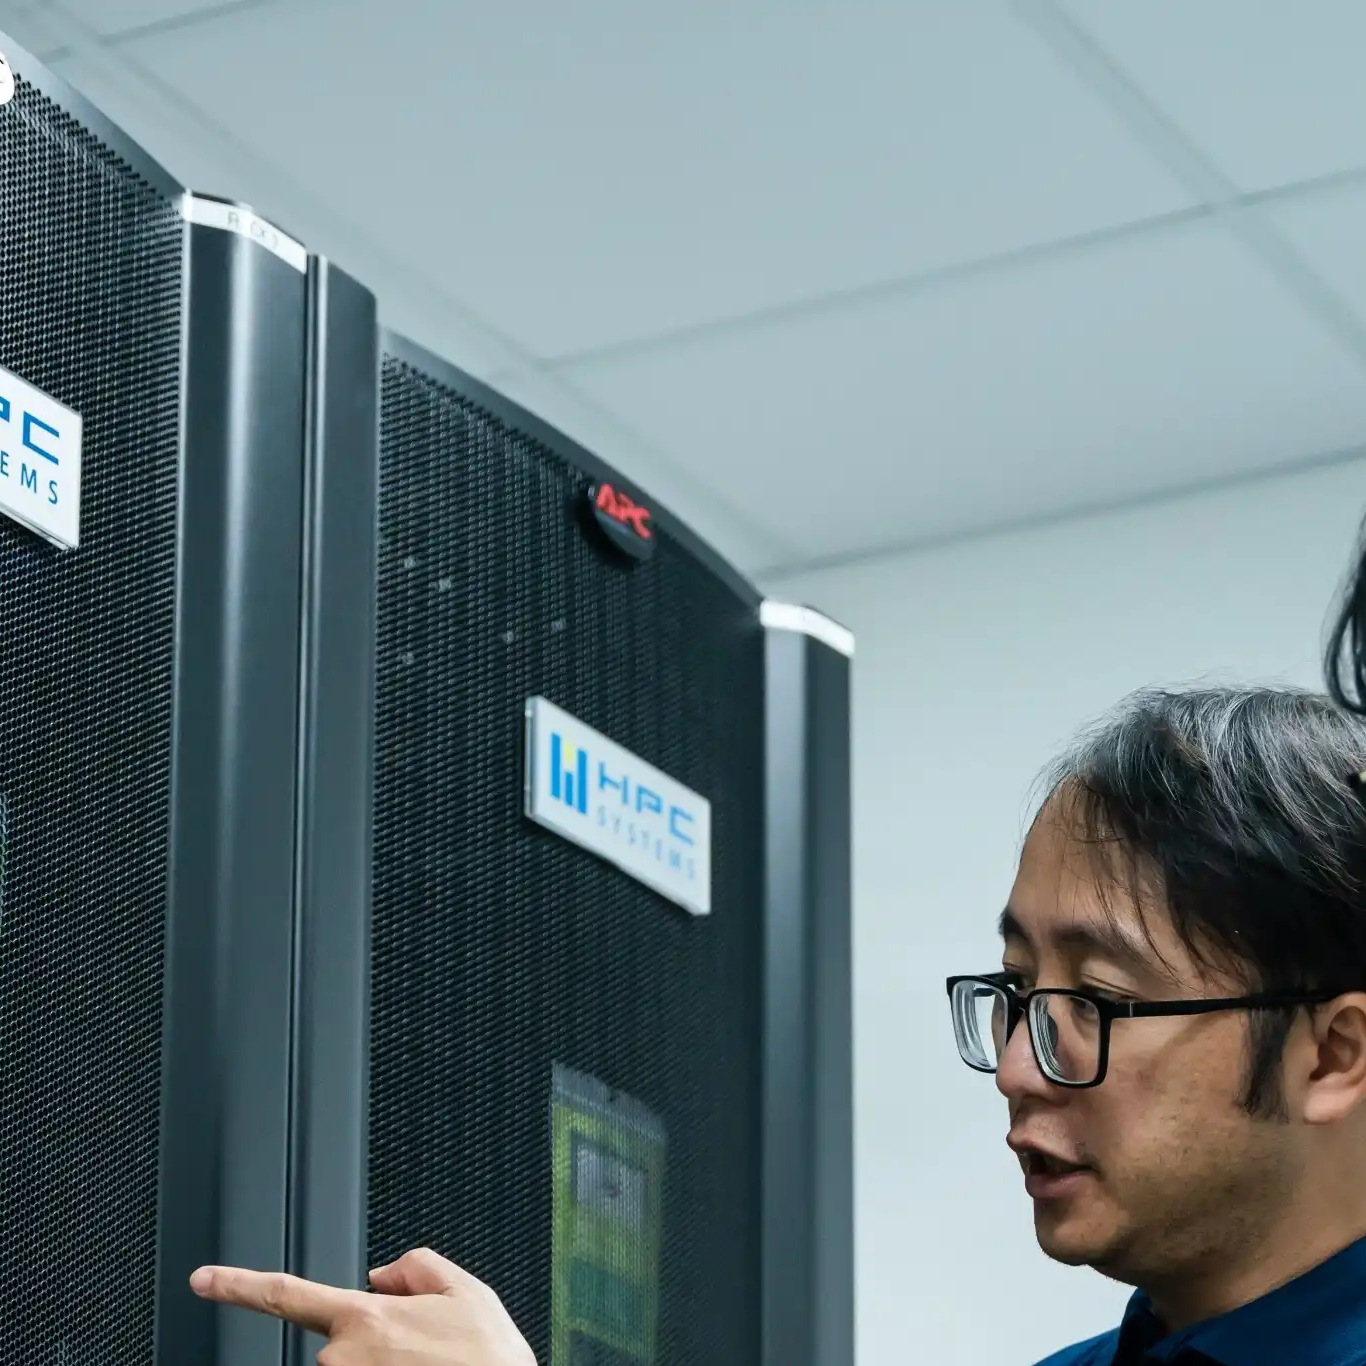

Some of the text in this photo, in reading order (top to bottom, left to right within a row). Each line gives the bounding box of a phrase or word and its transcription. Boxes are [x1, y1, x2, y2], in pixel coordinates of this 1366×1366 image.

[597, 483, 651, 539] APC
[598, 760, 694, 847] HPC
[596, 806, 696, 882] SYSTEMS
